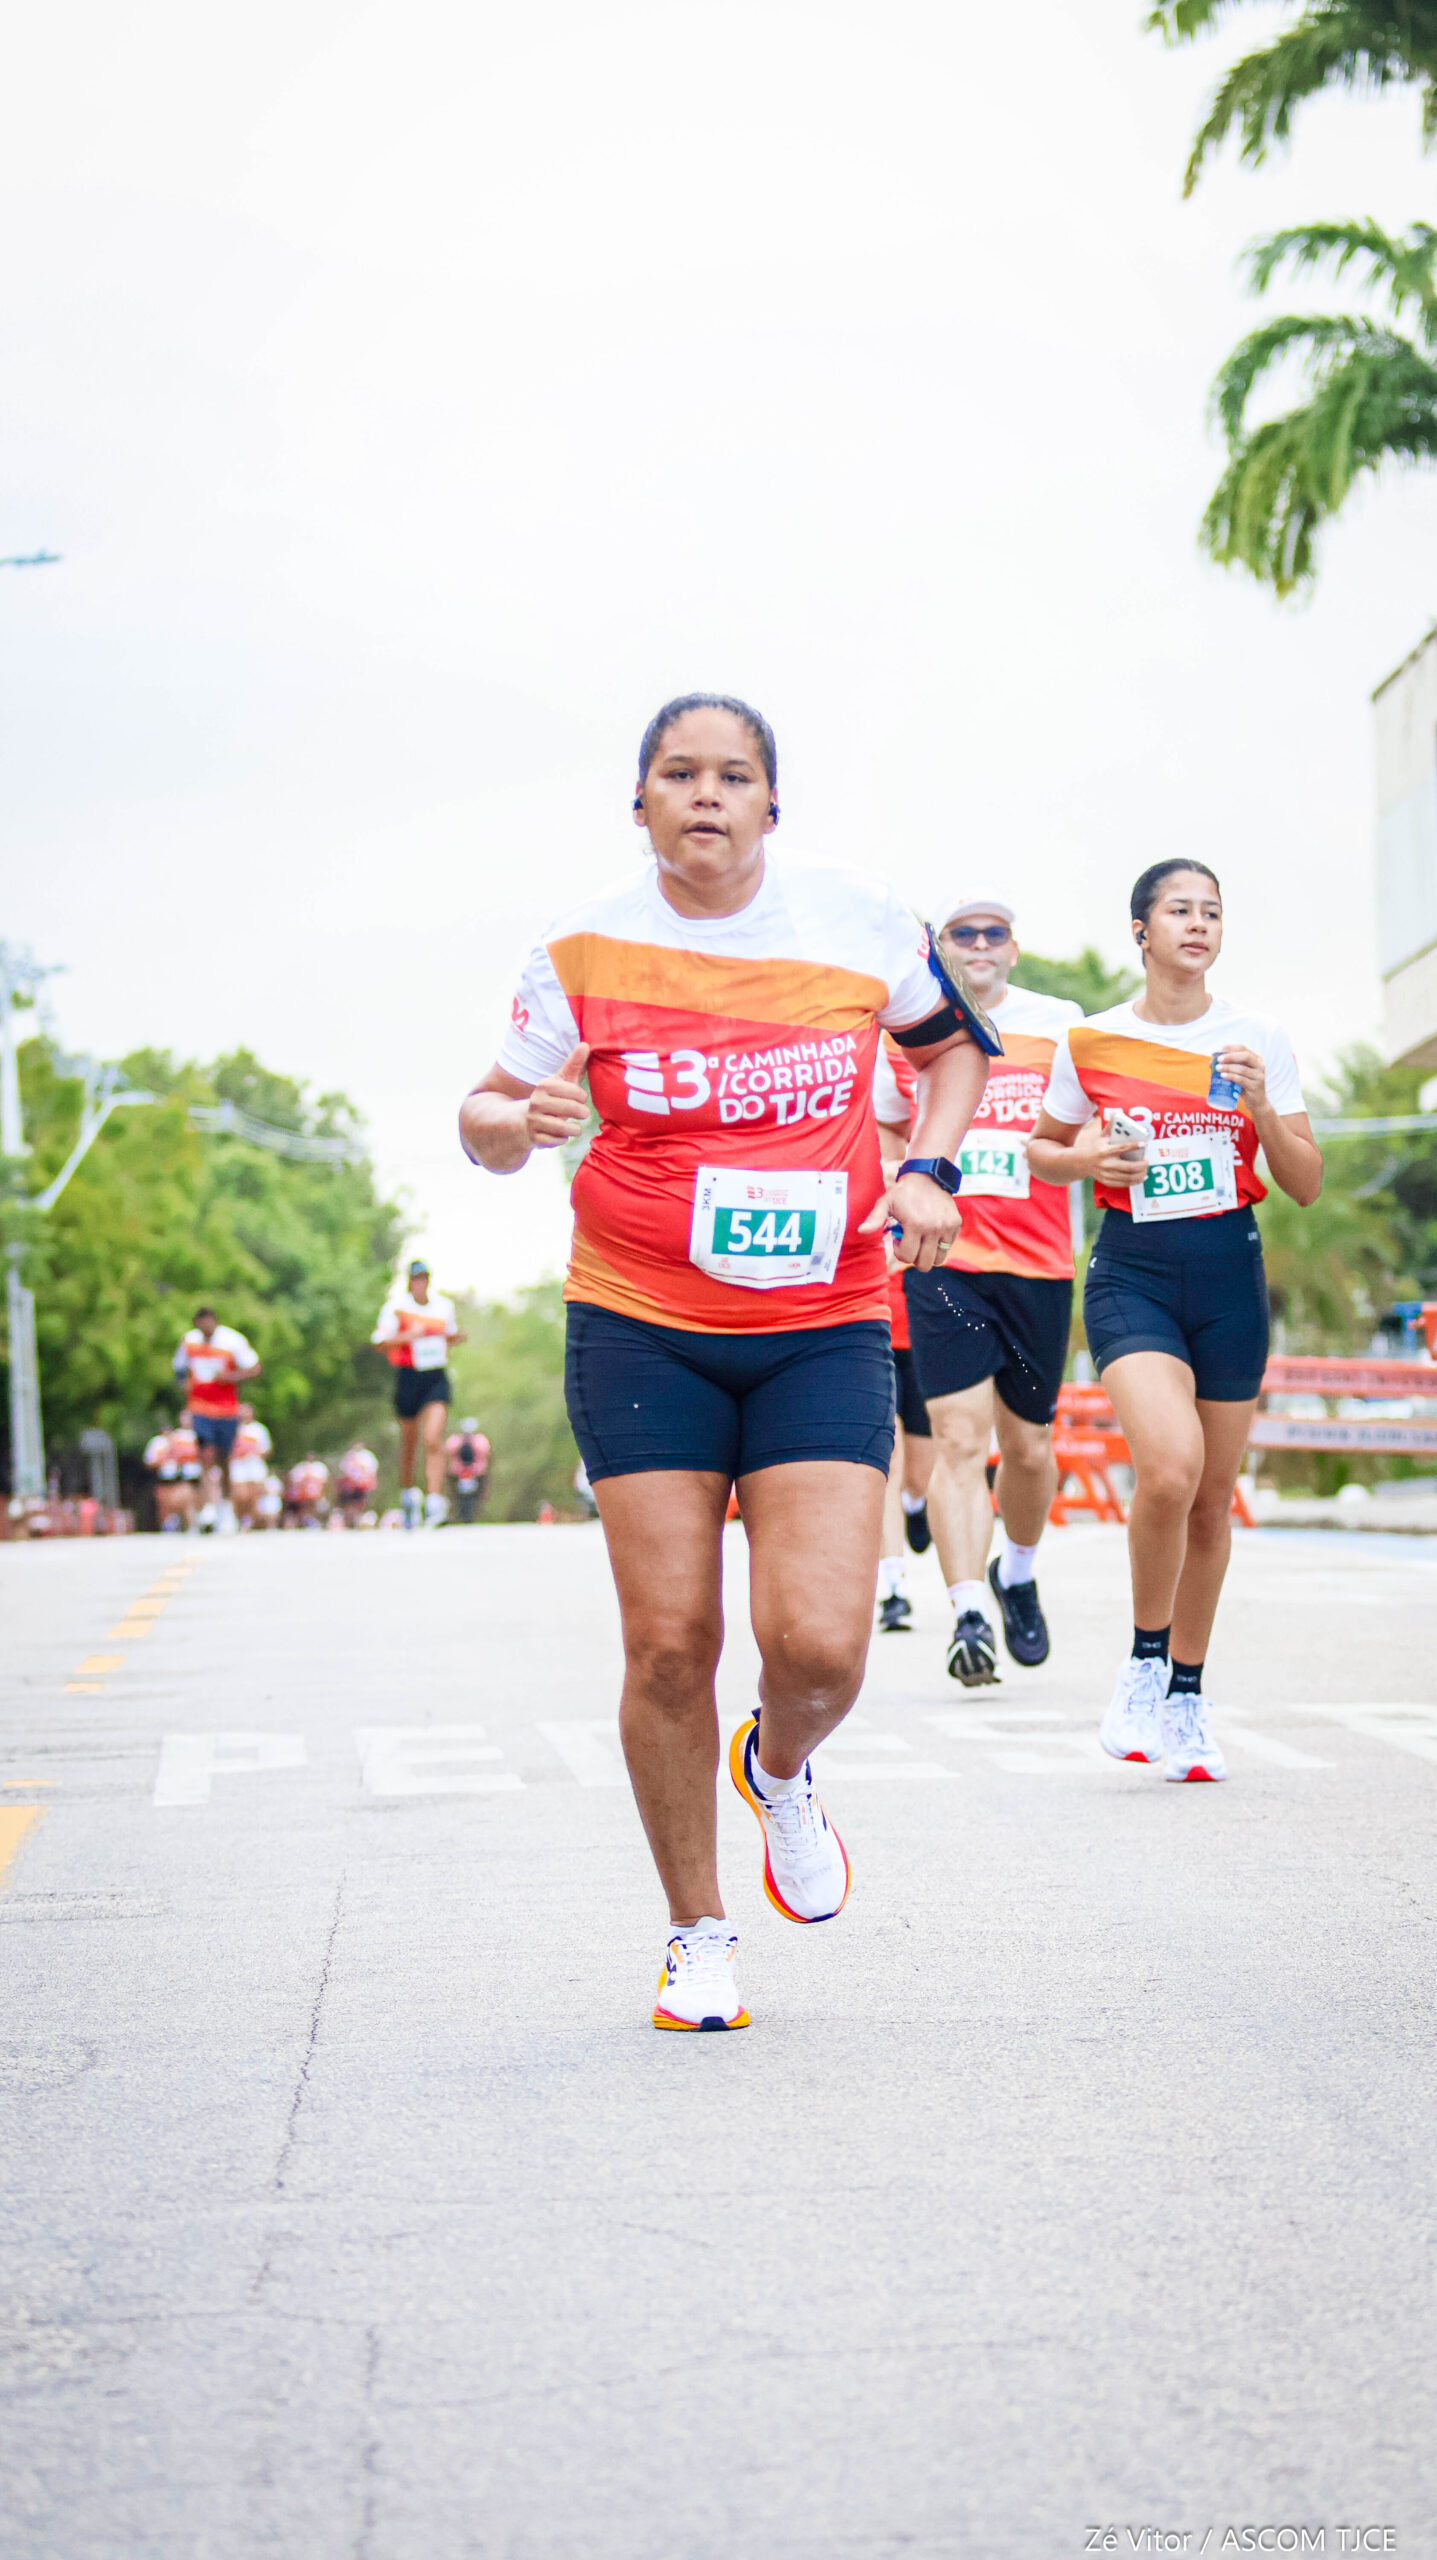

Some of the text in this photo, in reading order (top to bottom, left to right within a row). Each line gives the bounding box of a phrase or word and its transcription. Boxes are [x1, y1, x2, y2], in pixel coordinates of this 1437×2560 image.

[725, 1034, 857, 1071] CAMINHADA
[717, 1055, 858, 1097] /CORRIDA
[718, 1080, 854, 1125] DO TJCE
[1163, 1112, 1244, 1128] CAMINHADA
[967, 1151, 1010, 1175] 142
[1151, 1161, 1205, 1195] 308
[727, 1211, 802, 1253] 544
